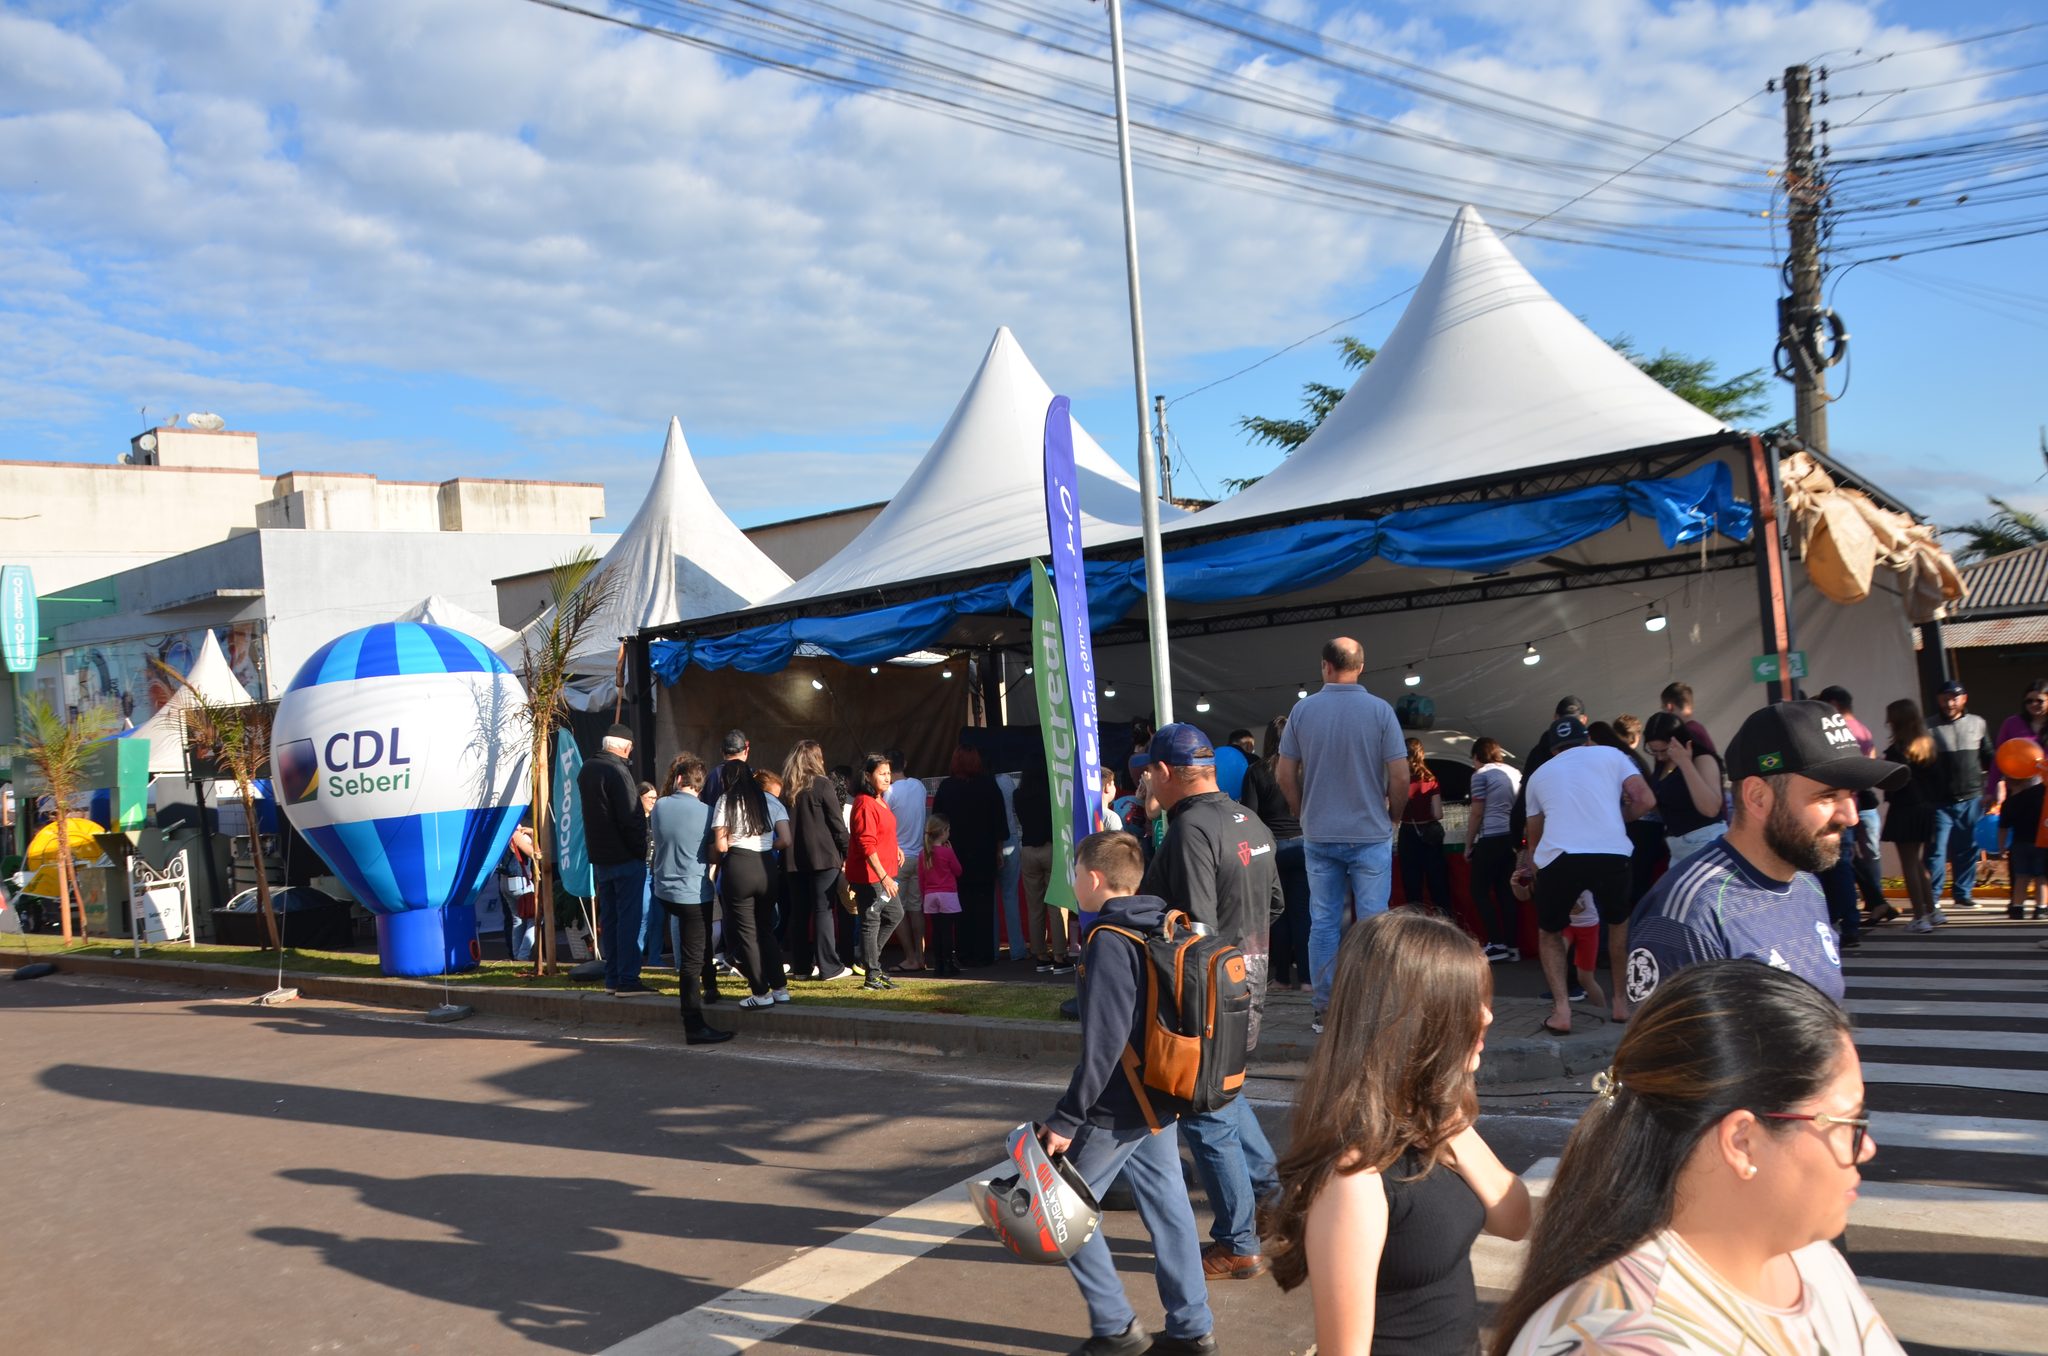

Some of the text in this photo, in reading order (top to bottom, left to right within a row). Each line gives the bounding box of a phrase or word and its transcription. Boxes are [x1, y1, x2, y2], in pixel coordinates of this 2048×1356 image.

[1042, 619, 1074, 811] Sicredi
[324, 727, 411, 772] CDL
[328, 767, 411, 798] Seberi
[560, 779, 573, 871] SICOOB
